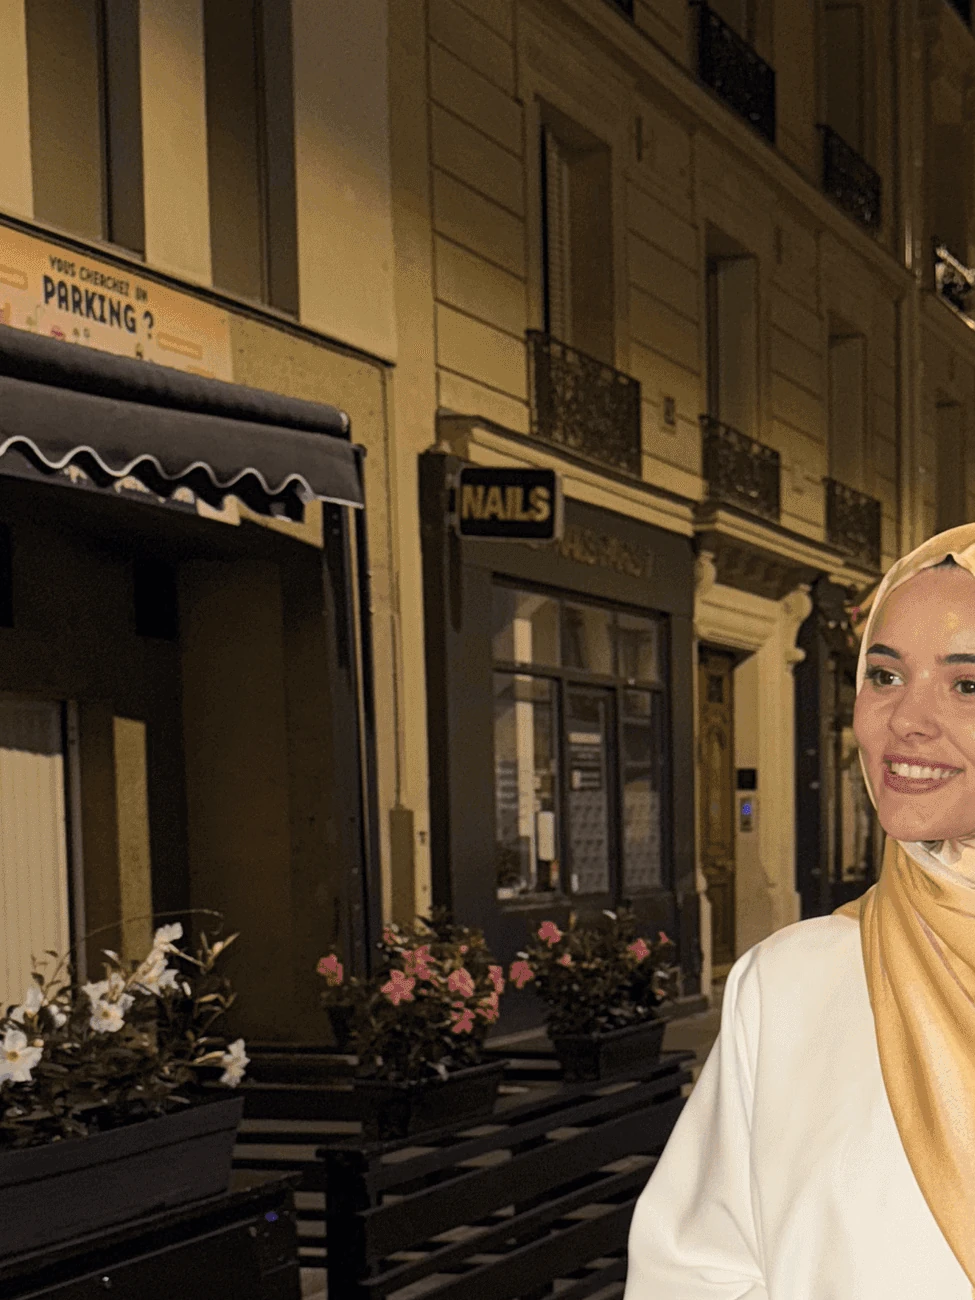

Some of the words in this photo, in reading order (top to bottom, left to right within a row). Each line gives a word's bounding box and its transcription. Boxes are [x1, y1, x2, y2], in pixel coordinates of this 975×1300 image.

[51, 256, 77, 277] VOUS
[79, 266, 130, 297] CHERCHEZ
[42, 274, 137, 334] PARKING
[461, 484, 551, 522] NAILS
